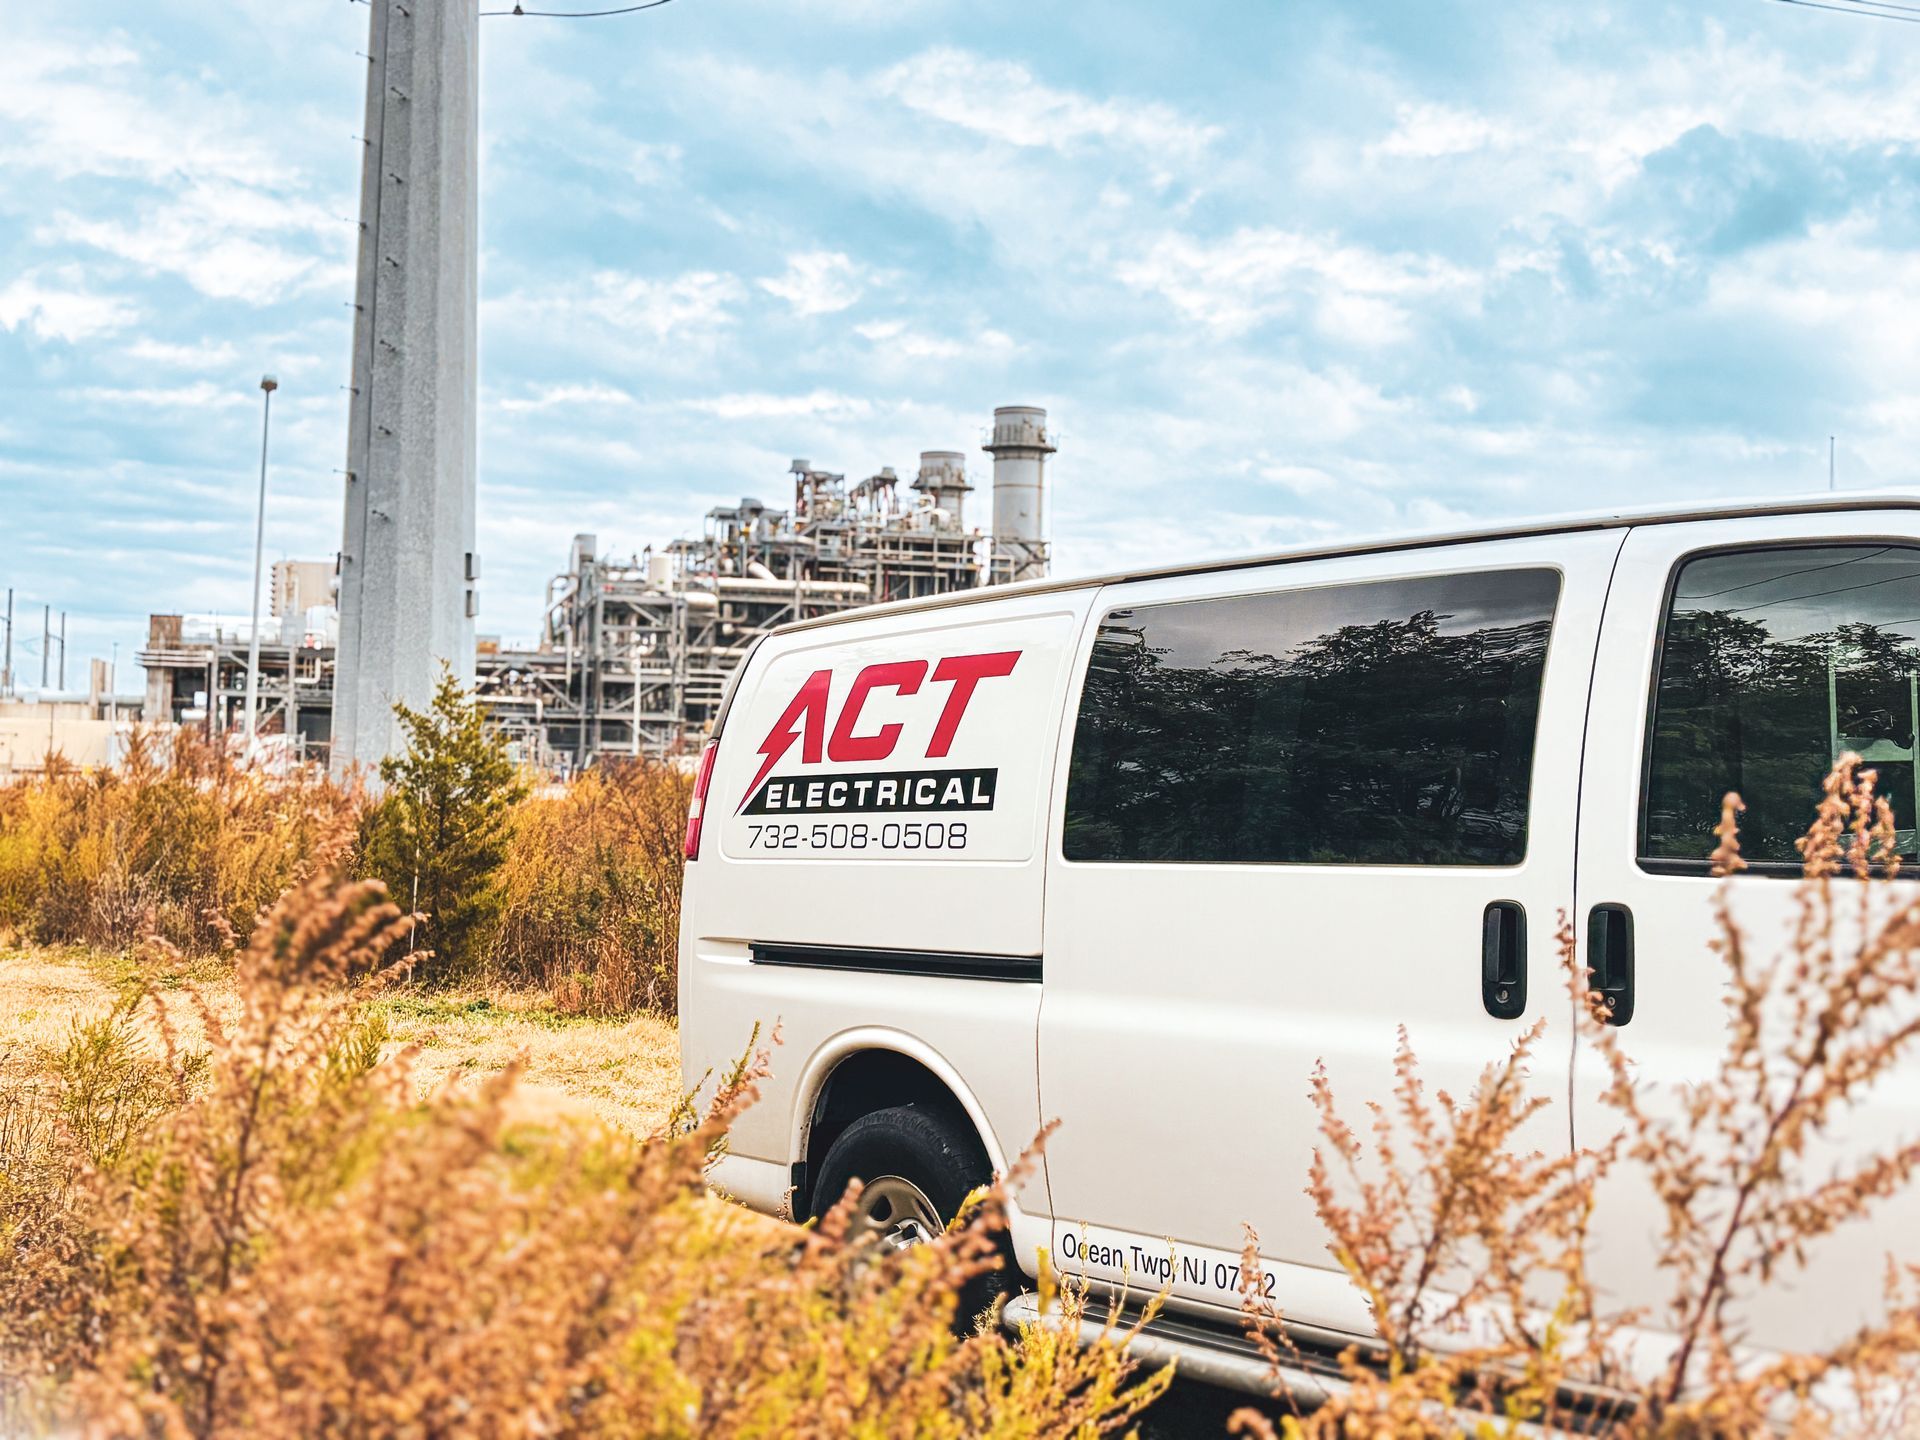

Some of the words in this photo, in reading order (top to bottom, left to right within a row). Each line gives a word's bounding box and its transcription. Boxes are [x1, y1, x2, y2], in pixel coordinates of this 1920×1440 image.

[733, 650, 1023, 817] ACT
[765, 777, 991, 809] ELECTRICAL
[748, 823, 968, 850] 732-508-0508
[1062, 1233, 1123, 1268] Ocean
[1183, 1255, 1207, 1286] NJ
[1214, 1263, 1276, 1300] 072
